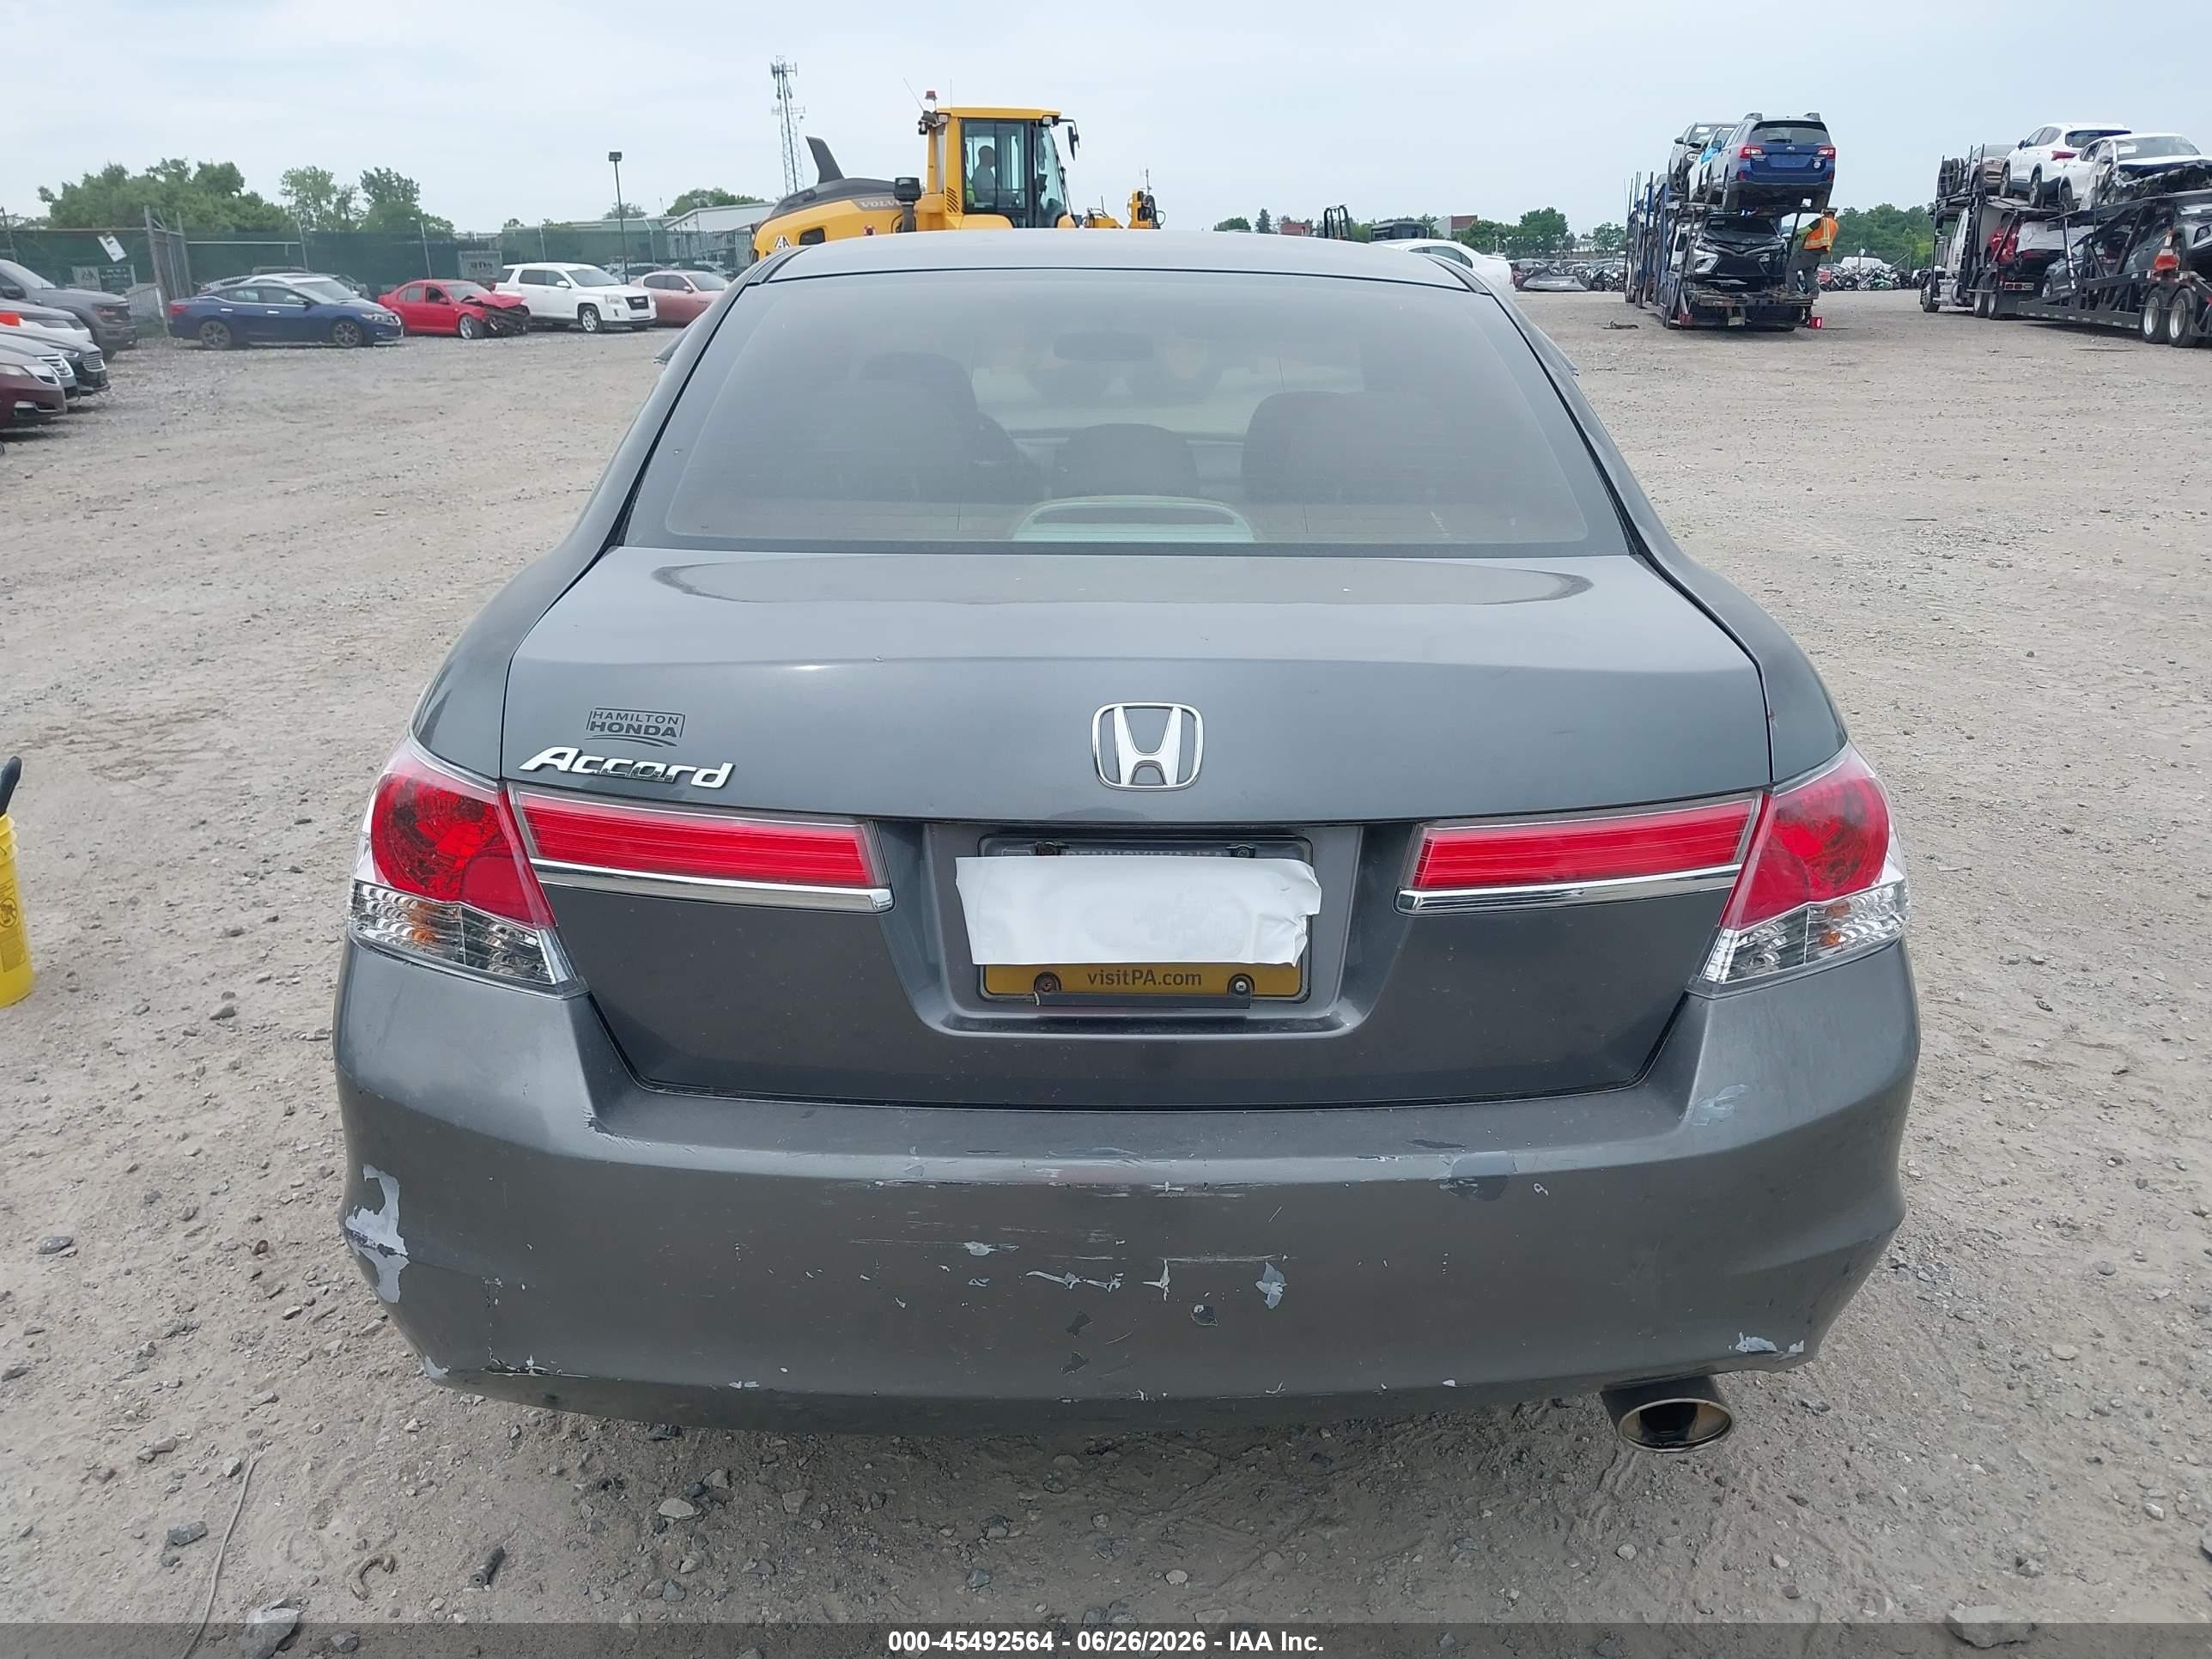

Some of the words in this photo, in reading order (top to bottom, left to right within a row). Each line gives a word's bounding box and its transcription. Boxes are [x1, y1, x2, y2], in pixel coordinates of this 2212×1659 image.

[592, 711, 679, 726] HAMILTON
[589, 721, 677, 738] HONDA
[518, 746, 733, 789] Accord
[1086, 969, 1202, 986] visitPA.com
